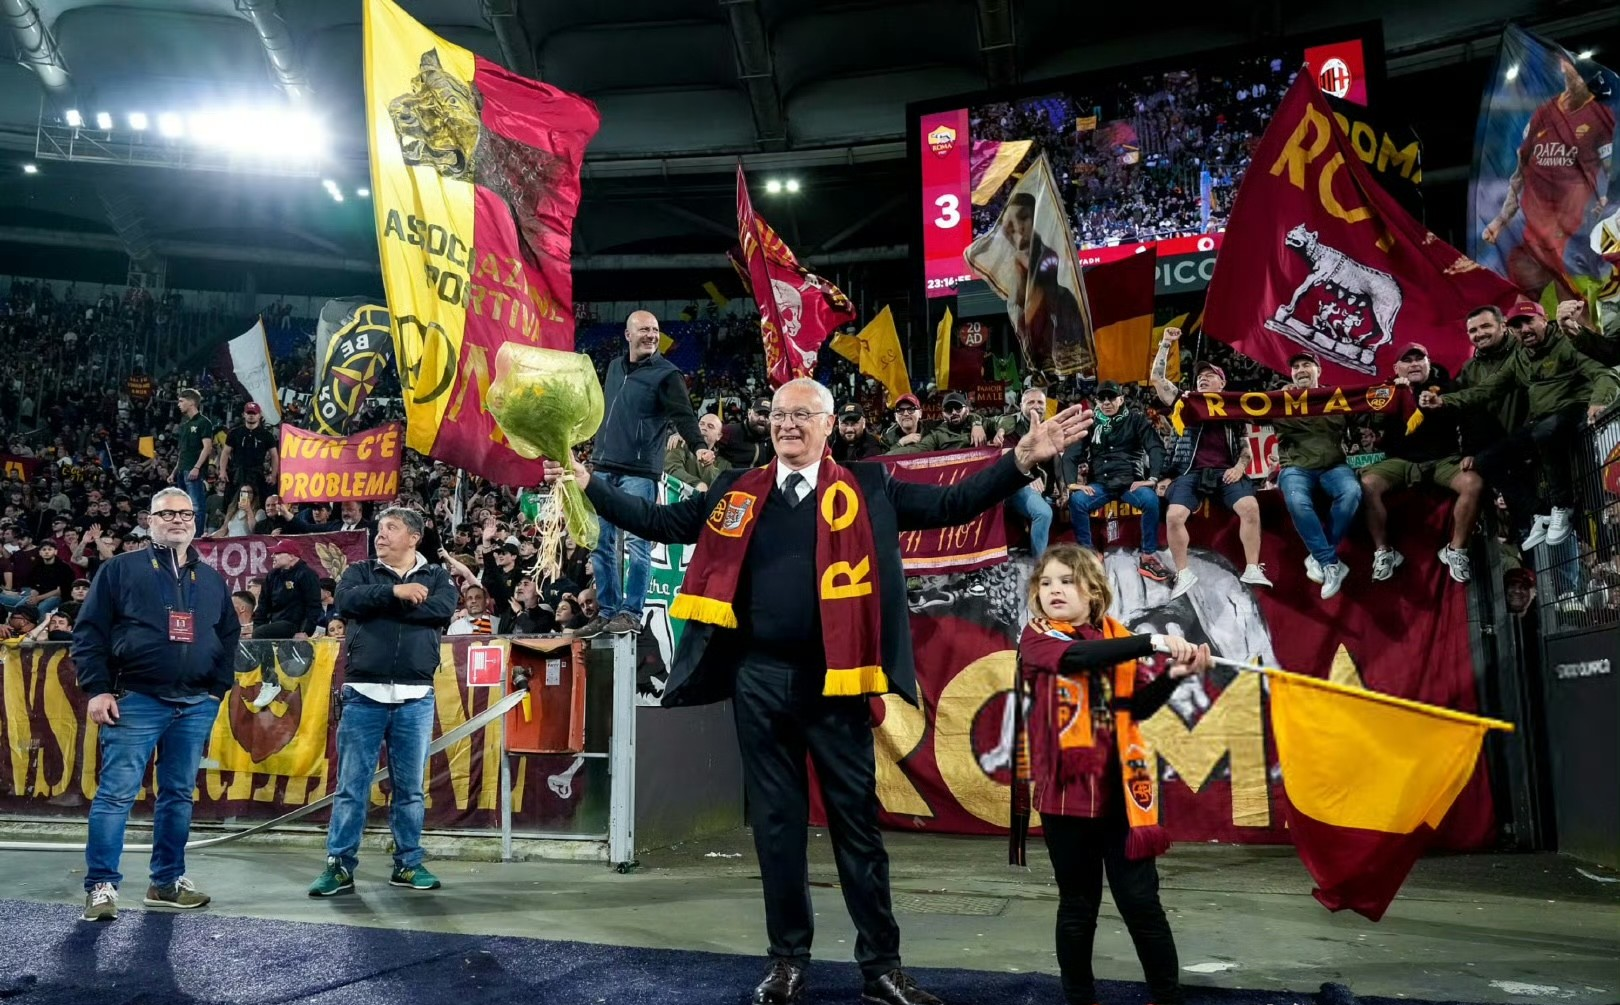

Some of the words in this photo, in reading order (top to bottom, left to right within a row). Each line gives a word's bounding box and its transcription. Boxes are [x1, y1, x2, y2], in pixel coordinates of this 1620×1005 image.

[1533, 142, 1578, 159] QATAR
[1536, 156, 1575, 167] AIRWAYS
[934, 194, 960, 229] 3
[967, 322, 981, 333] 20
[965, 333, 983, 345] AD
[977, 392, 1002, 401] MALE
[1203, 387, 1352, 417] ROMA
[279, 470, 398, 499] PROBLEMA
[820, 480, 873, 600] RO
